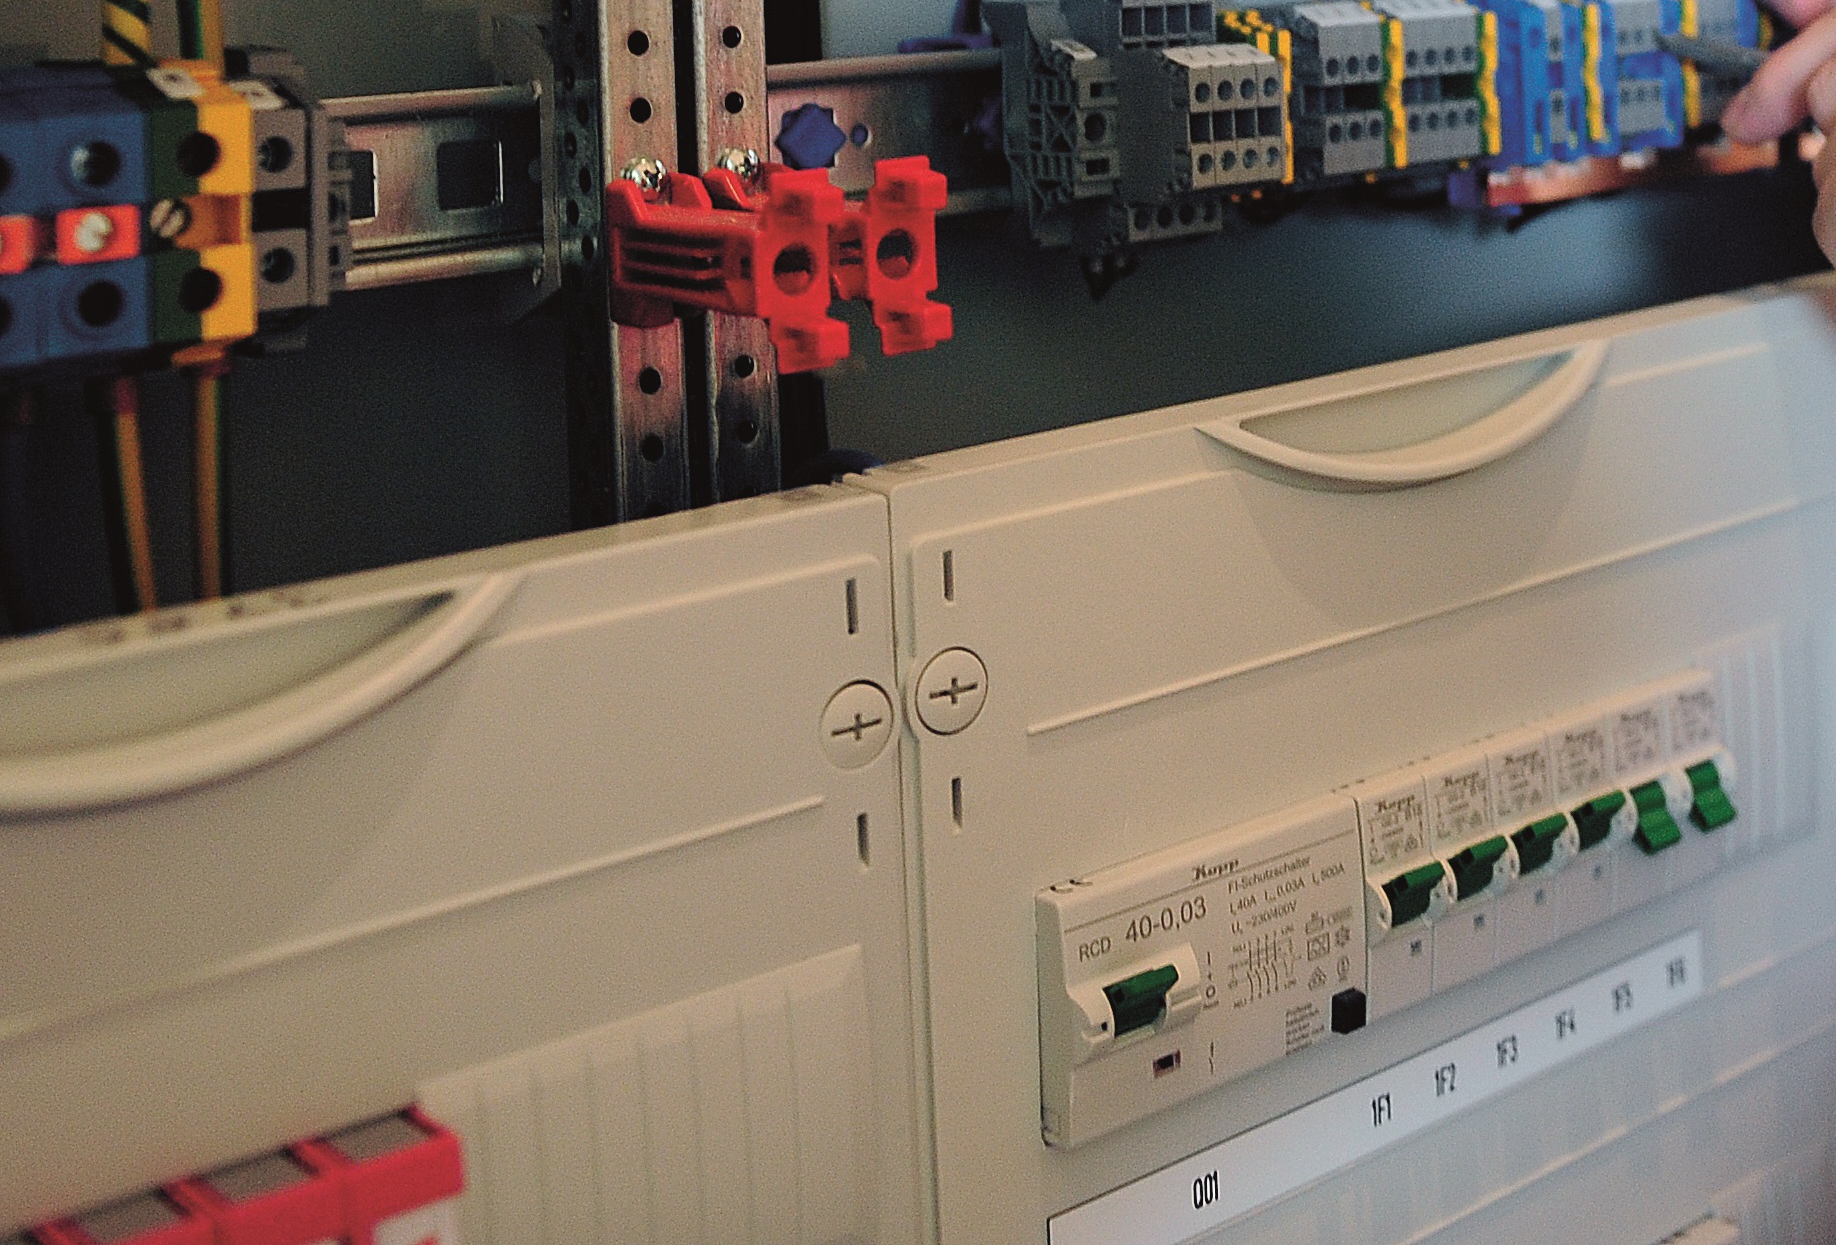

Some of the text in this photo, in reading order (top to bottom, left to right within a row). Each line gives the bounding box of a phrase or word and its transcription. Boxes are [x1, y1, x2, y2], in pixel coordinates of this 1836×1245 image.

[1078, 895, 1207, 962] RCD 40-0,03
[1371, 1091, 1393, 1128] 1F1
[1435, 1062, 1457, 1098] 1F2
